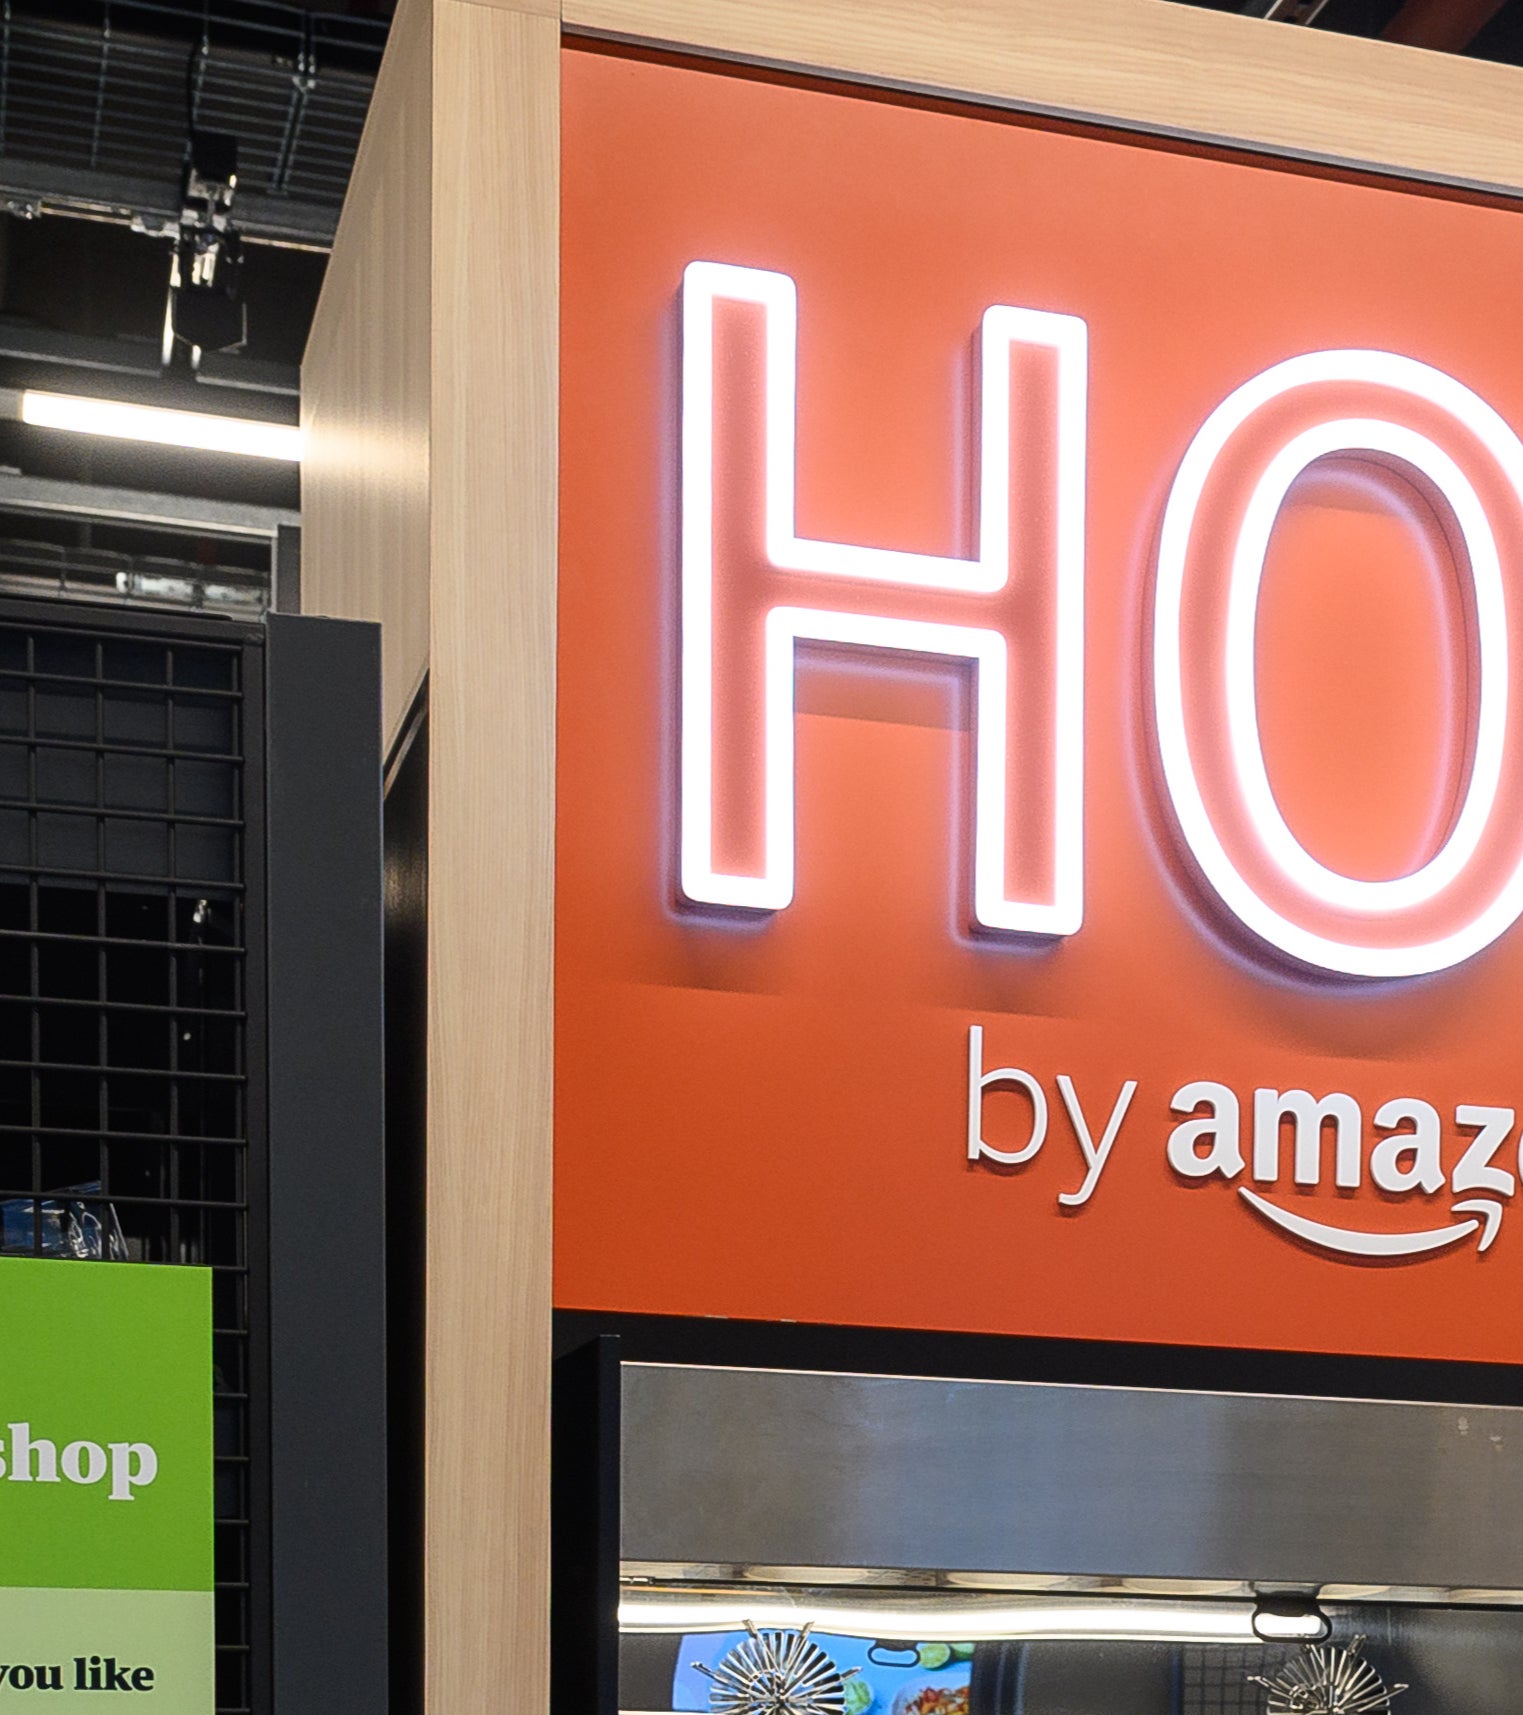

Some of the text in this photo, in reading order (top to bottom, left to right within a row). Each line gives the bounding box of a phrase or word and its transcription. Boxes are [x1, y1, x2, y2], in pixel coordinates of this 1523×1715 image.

[965, 1025, 1138, 1207] by
[0, 1421, 158, 1500] hop
[73, 1655, 154, 1693] like
